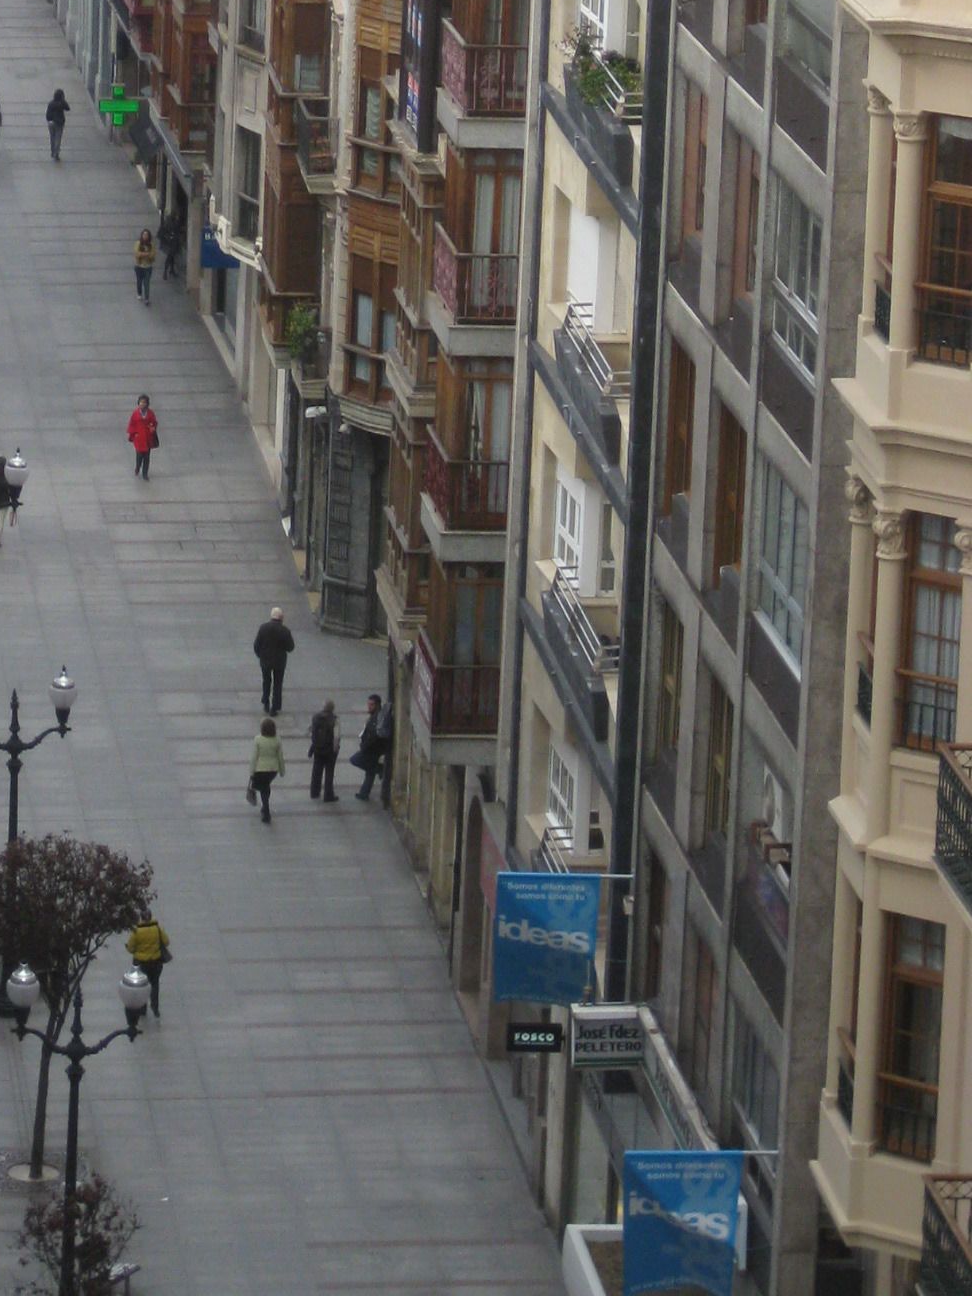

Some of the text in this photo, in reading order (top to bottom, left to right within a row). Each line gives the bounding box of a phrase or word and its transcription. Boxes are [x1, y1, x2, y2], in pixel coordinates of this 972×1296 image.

[498, 914, 590, 954] ideas
[513, 1032, 555, 1042] FOSCO
[578, 1024, 606, 1039] José
[575, 1040, 642, 1053] PELETERO
